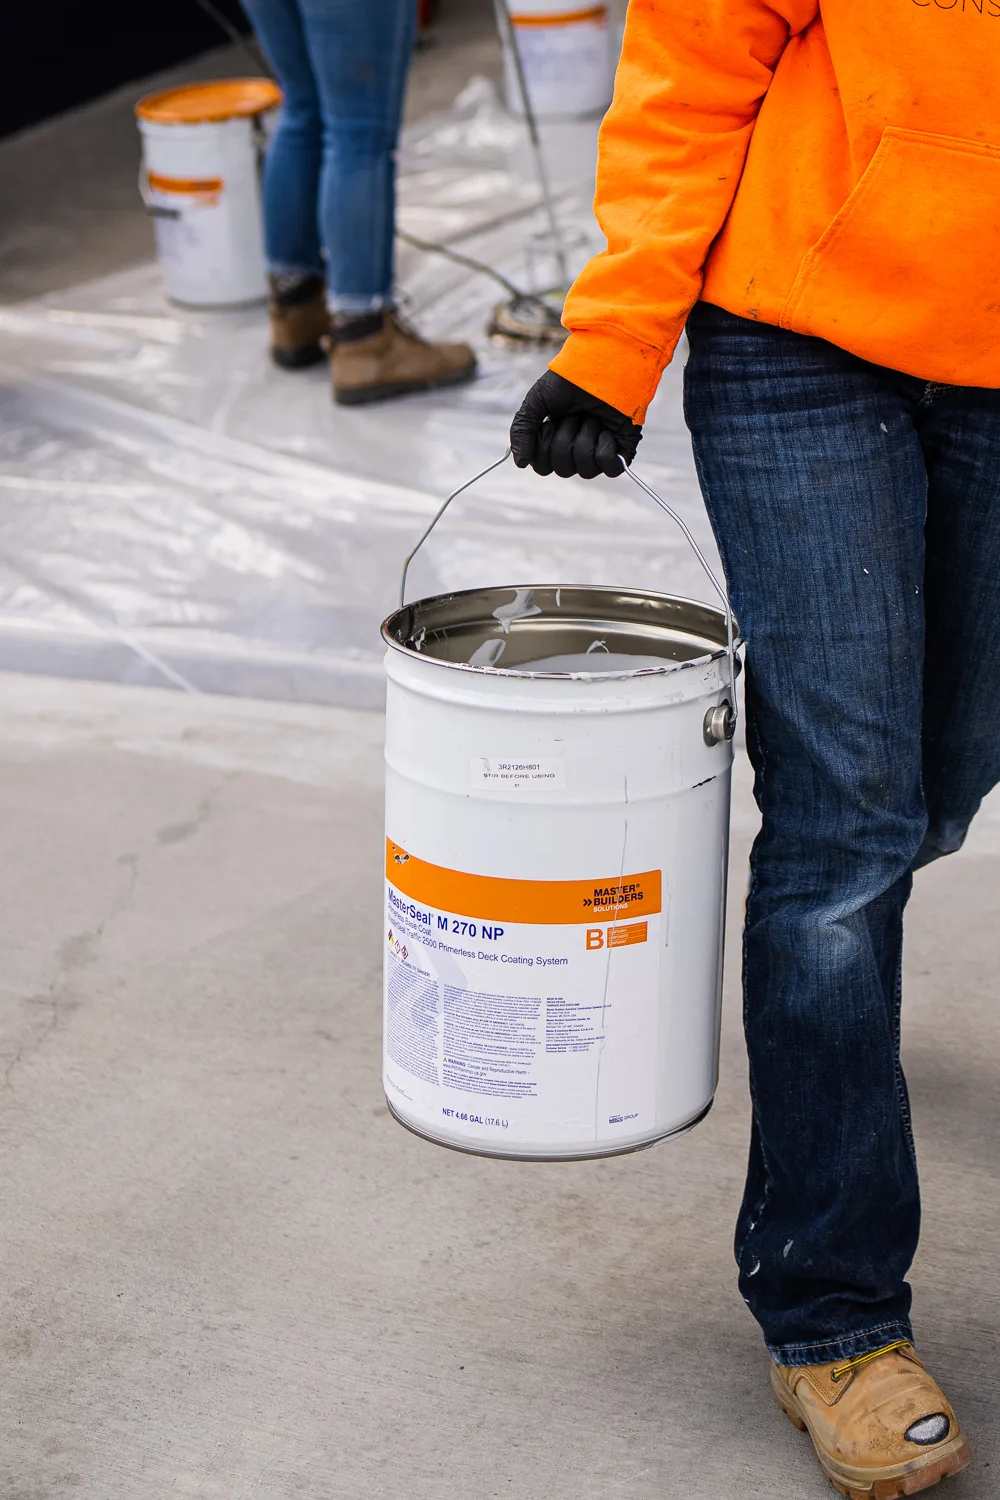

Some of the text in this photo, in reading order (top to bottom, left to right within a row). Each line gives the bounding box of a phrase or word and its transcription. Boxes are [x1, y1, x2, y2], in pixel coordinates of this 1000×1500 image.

[593, 891, 644, 906] BUILDERS
[593, 903, 629, 913] SOLUTIONS
[405, 917, 417, 930] Base
[418, 924, 432, 937] Coat
[437, 915, 448, 931] M
[452, 920, 477, 938] 270
[482, 926, 504, 941] NP
[586, 928, 604, 950] B
[422, 936, 437, 949] 2500
[438, 942, 476, 959] Primerless
[478, 951, 498, 962] Deck
[501, 955, 533, 966] Coating
[535, 956, 568, 967] System
[442, 1107, 509, 1129] NET 4.66 GAL (17.6 L)
